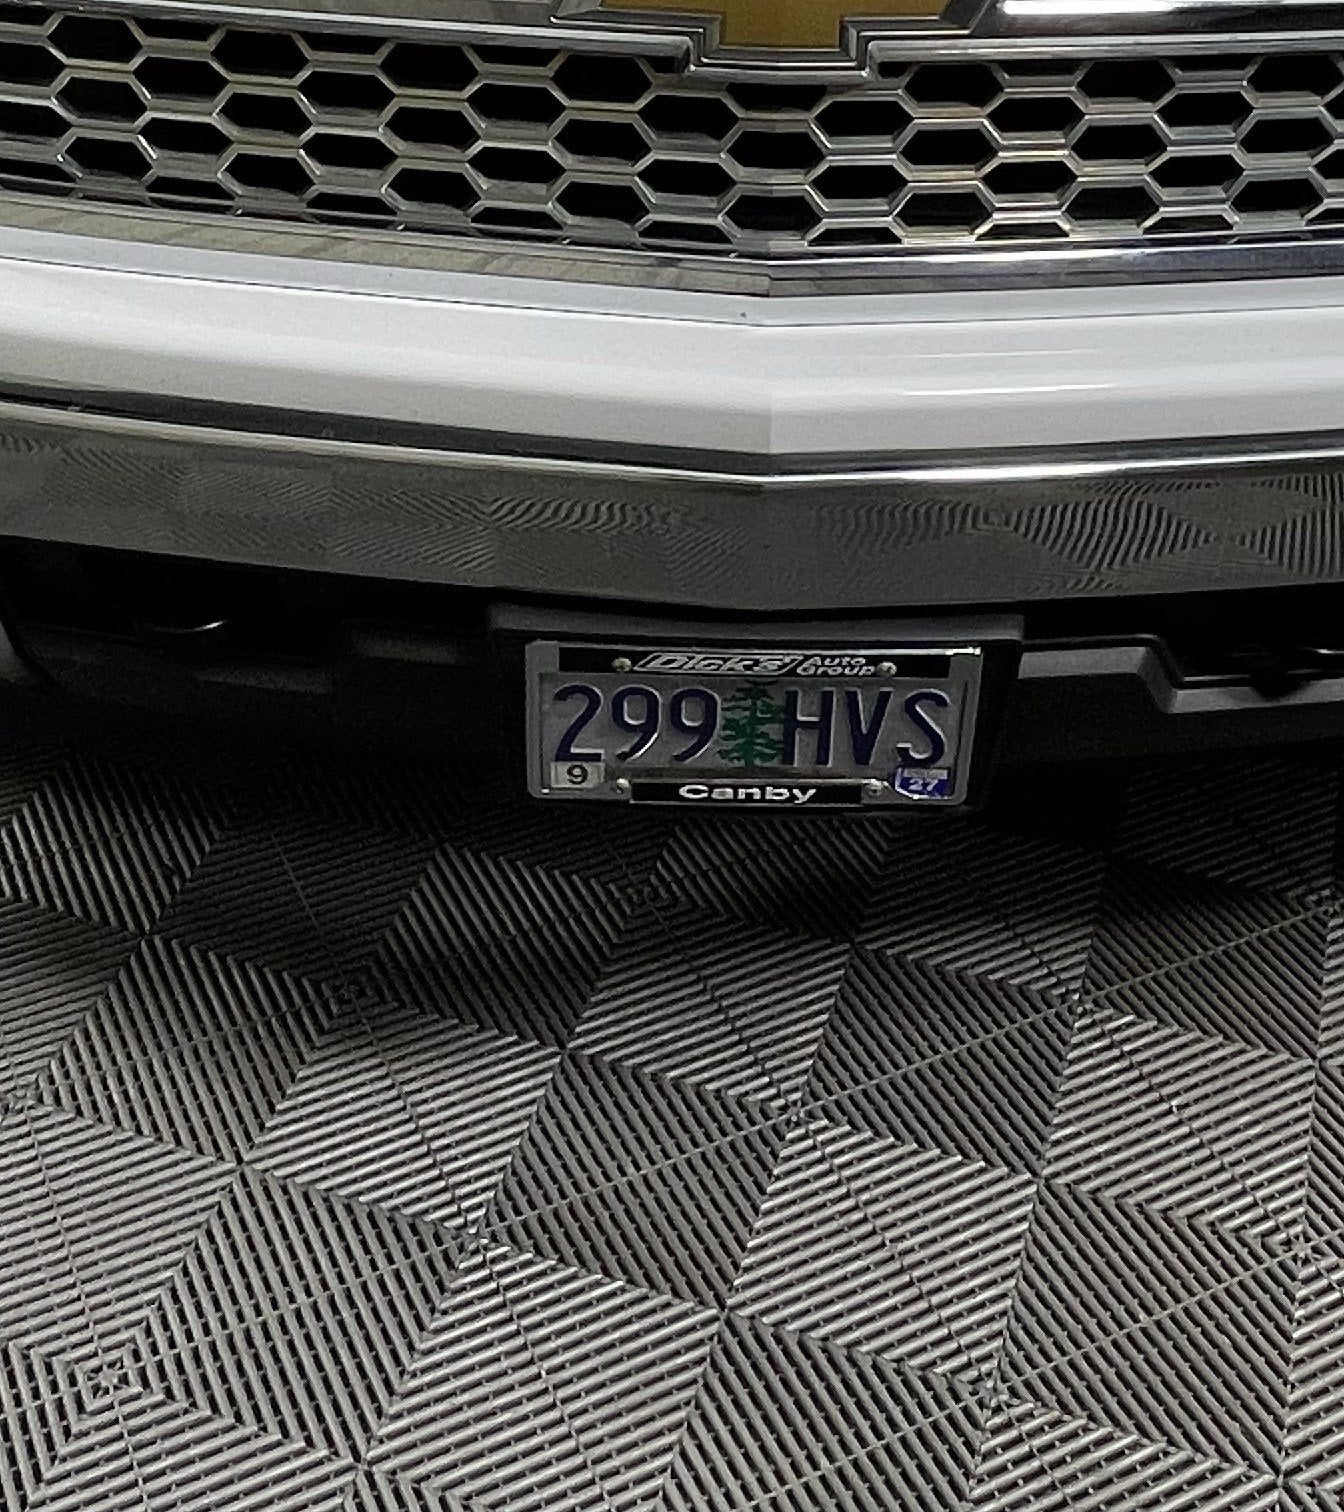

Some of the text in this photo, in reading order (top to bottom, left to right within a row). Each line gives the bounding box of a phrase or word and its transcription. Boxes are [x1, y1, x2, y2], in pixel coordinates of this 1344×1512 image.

[797, 665, 876, 676] Group
[803, 656, 866, 666] Auto
[553, 684, 953, 767] 299 HVS
[567, 764, 589, 785] 9
[679, 784, 817, 804] Canby
